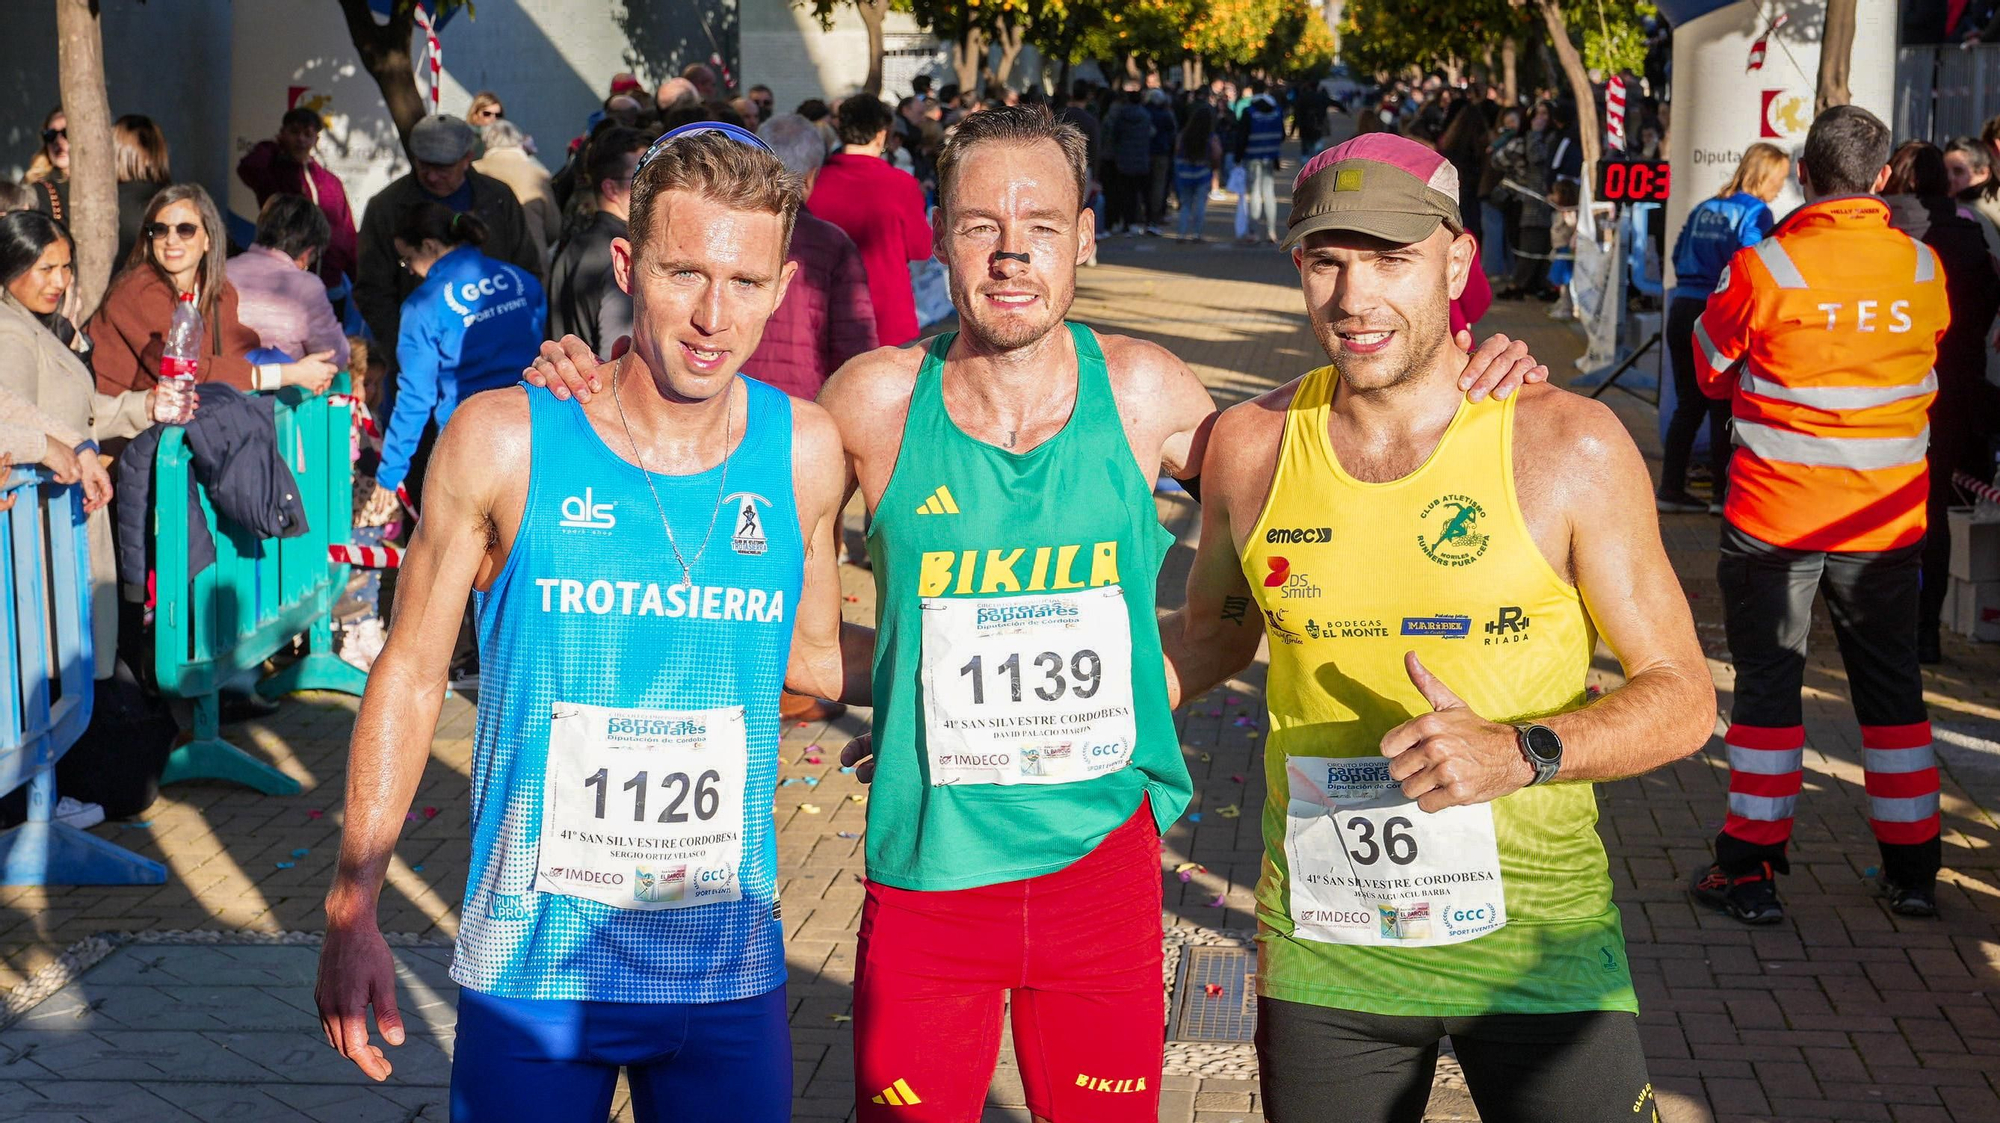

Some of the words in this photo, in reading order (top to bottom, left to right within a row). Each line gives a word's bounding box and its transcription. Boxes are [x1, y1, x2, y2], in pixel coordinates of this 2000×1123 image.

[1694, 149, 1742, 165] Diputa
[461, 274, 509, 302] GCC
[1818, 300, 1912, 333] TES
[1420, 499, 1440, 518] CLUB
[1443, 495, 1486, 518] ATLETISMO
[1266, 528, 1315, 543] emec
[1417, 535, 1448, 566] RUNNERS
[1452, 556, 1477, 567] PURA
[1477, 535, 1490, 556] CEPA
[917, 541, 1121, 598] BIKILA
[1290, 574, 1308, 587] DS
[1281, 585, 1321, 598] Smith
[536, 578, 783, 623] TROTASIERRA
[977, 602, 1061, 615] carreras
[977, 607, 1079, 624] populares
[1327, 620, 1382, 628] BODEGAS
[1322, 630, 1337, 638] EL
[1342, 628, 1389, 637] MONTE
[1484, 634, 1529, 645] RIADA
[961, 649, 1101, 704] 1139
[609, 717, 694, 728] carreras
[961, 719, 985, 729] SAN
[989, 715, 1057, 728] SILVESTRE
[1060, 707, 1129, 724] CORDOBESA
[608, 724, 706, 736] populares
[994, 731, 1020, 739] DAVID
[1022, 729, 1060, 737] PALACIO
[1092, 743, 1119, 756] GCC
[954, 754, 1010, 766] IMDECO
[1328, 767, 1390, 775] carrera
[1328, 771, 1393, 784] popula
[585, 768, 720, 823] 1126
[580, 832, 603, 844] SAN
[606, 836, 677, 849] SILVESTRE
[680, 831, 737, 847] CORDOBESA
[1347, 816, 1418, 866] 36
[610, 850, 644, 859] SERGIO
[674, 850, 706, 859] VELASCO
[566, 869, 624, 885] IMDECO
[702, 869, 725, 882] GCC
[1323, 875, 1345, 886] SAN
[1348, 878, 1412, 889] SILVESTRE
[1414, 871, 1494, 887] CORDOBESA
[1378, 891, 1420, 900] ALGUACIL
[1422, 888, 1451, 897] BARBA
[496, 896, 520, 908] RUN
[498, 907, 524, 919] PRO
[1316, 911, 1371, 924] IMDECO
[1454, 909, 1485, 922] GCC
[1449, 929, 1469, 937] SPORT
[1471, 924, 1494, 934] EVENTS
[1075, 1073, 1146, 1093] BIKILA
[1633, 1089, 1647, 1112] CLUB
